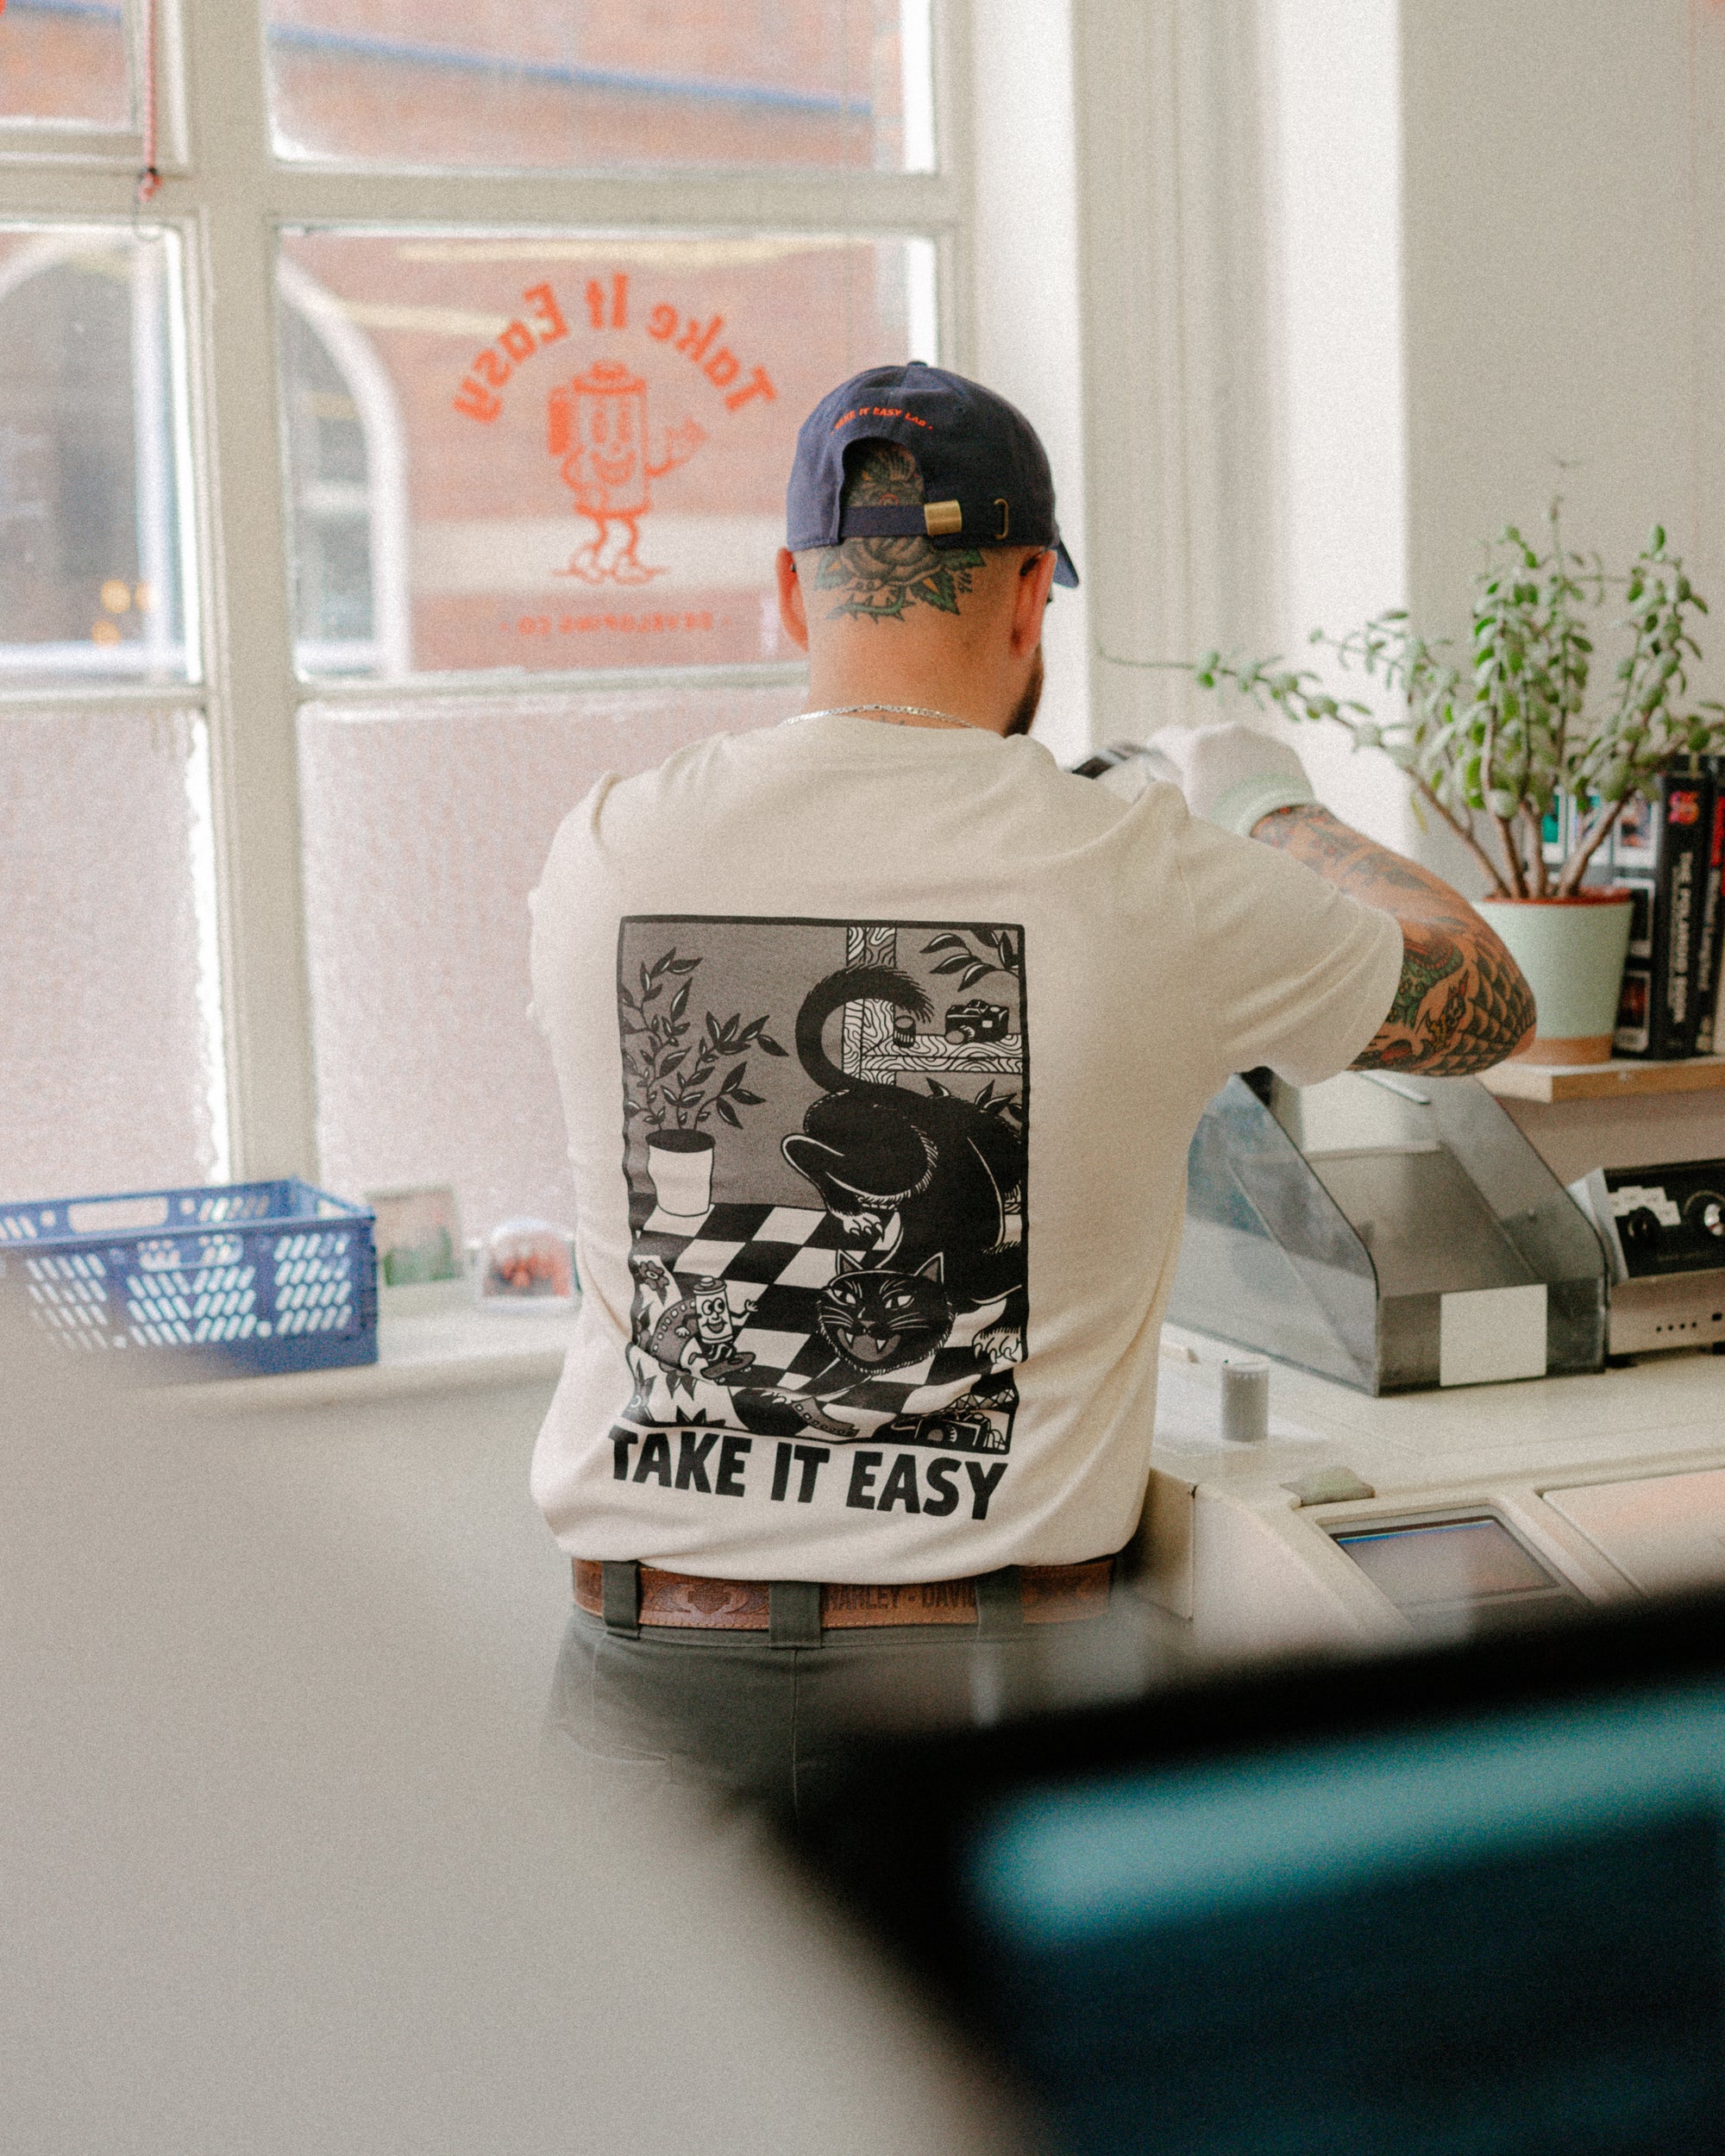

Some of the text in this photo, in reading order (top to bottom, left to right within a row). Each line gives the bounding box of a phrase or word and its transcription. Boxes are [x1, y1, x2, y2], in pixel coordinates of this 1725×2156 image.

[834, 410, 856, 429] TAKE
[858, 407, 870, 417] IT
[873, 406, 902, 417] EASY
[1679, 851, 1692, 883] THE
[607, 1425, 1008, 1520] TAKE IT EASY
[823, 1583, 900, 1611] HARLEY
